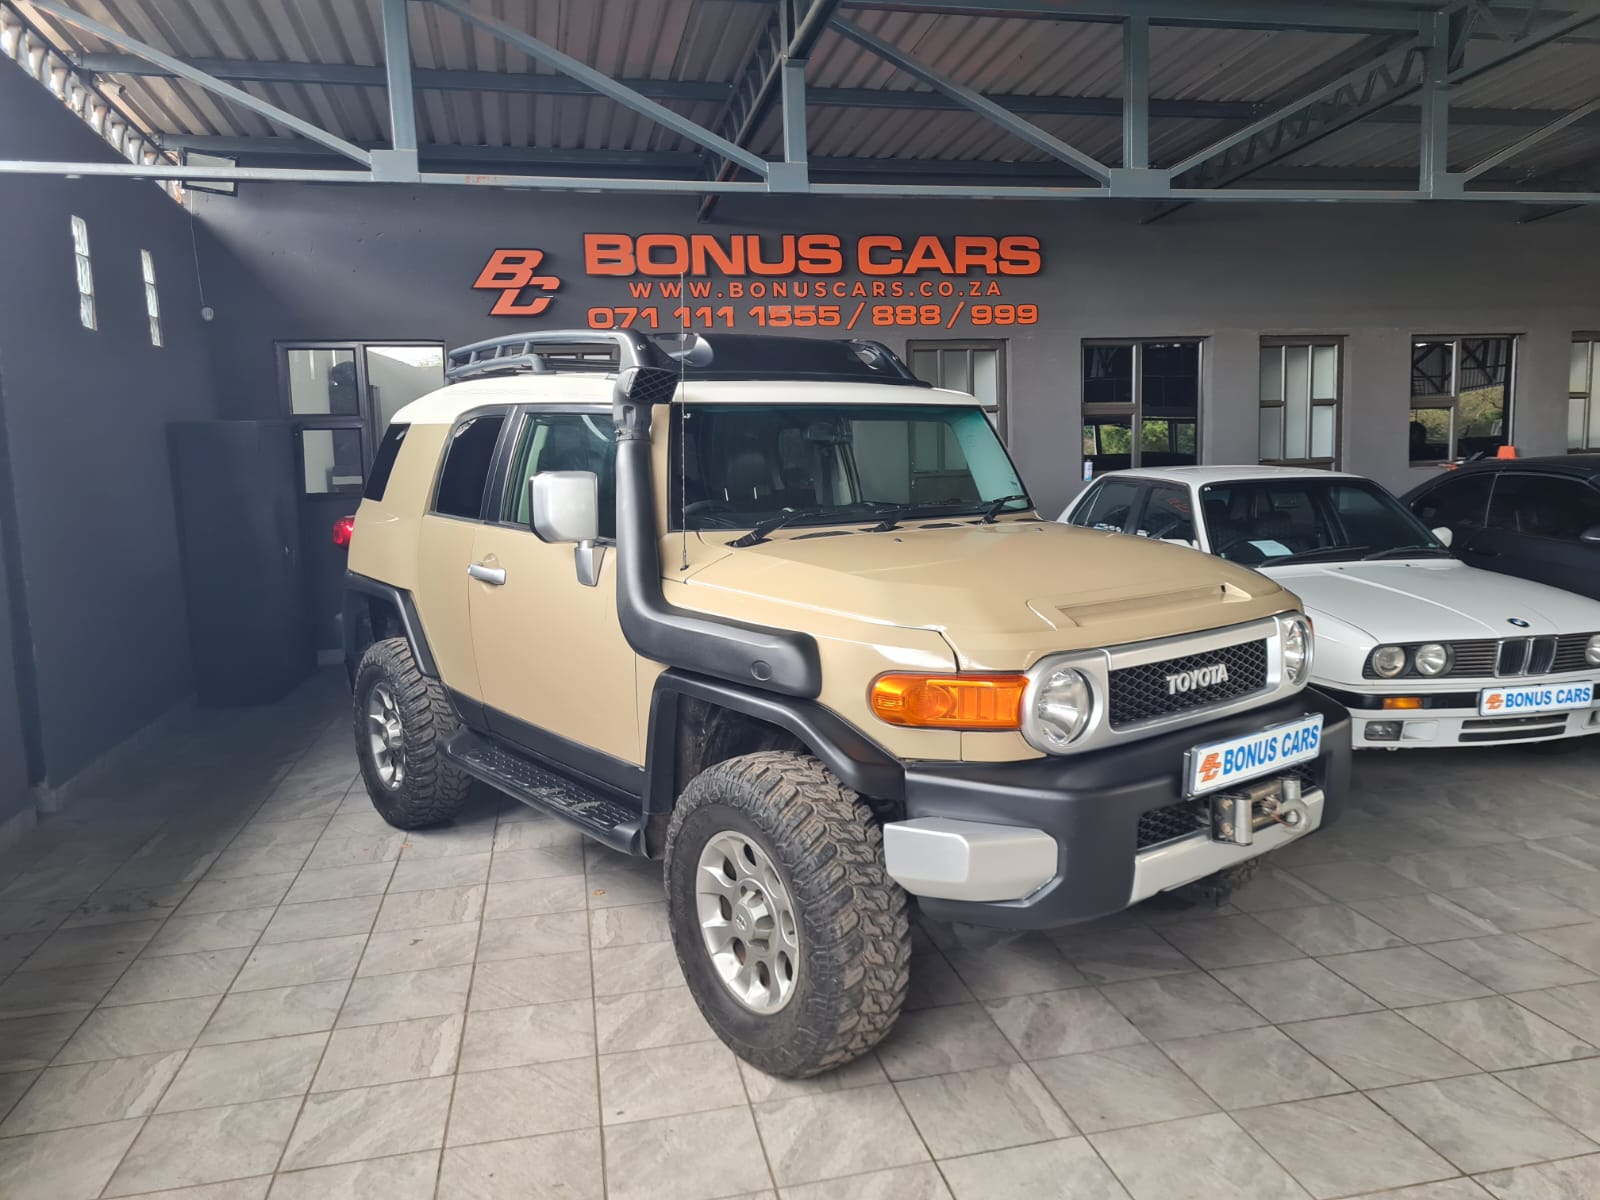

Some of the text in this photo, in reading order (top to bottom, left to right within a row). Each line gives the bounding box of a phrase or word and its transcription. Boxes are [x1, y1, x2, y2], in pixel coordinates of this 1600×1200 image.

[584, 233, 1041, 276] BONUS CARS
[472, 249, 561, 316] BC
[629, 280, 1002, 299] WWW.BONUSCARS.CO.ZA
[587, 307, 659, 329] 071
[673, 305, 735, 328] 111
[749, 304, 841, 327] 1555
[872, 304, 941, 326] 888
[971, 304, 1039, 326] 999
[1166, 664, 1229, 695] TOYOTA
[1505, 691, 1552, 708] BONUS
[1556, 687, 1591, 704] CARS
[1222, 737, 1278, 775] BONUS
[1281, 725, 1319, 758] CARS
